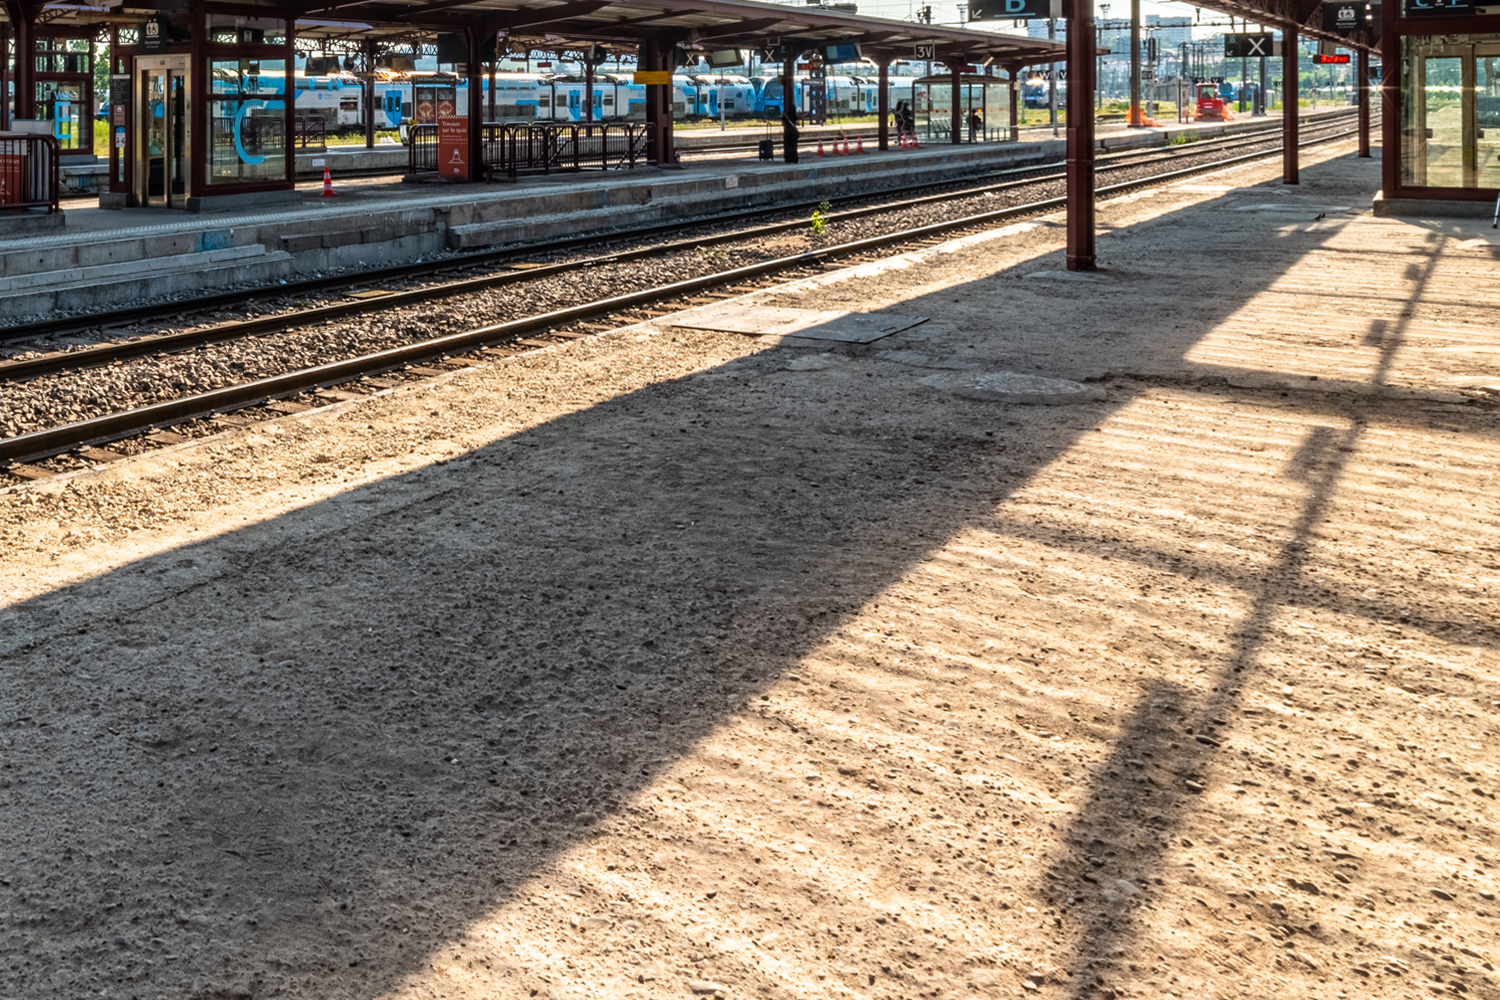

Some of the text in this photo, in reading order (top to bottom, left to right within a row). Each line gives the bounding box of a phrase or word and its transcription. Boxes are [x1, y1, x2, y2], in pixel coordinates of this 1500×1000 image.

[917, 46, 933, 57] 3V
[1248, 38, 1265, 55] X
[686, 54, 695, 64] X
[765, 50, 775, 62] X
[54, 101, 71, 139] E
[234, 98, 264, 164] C
